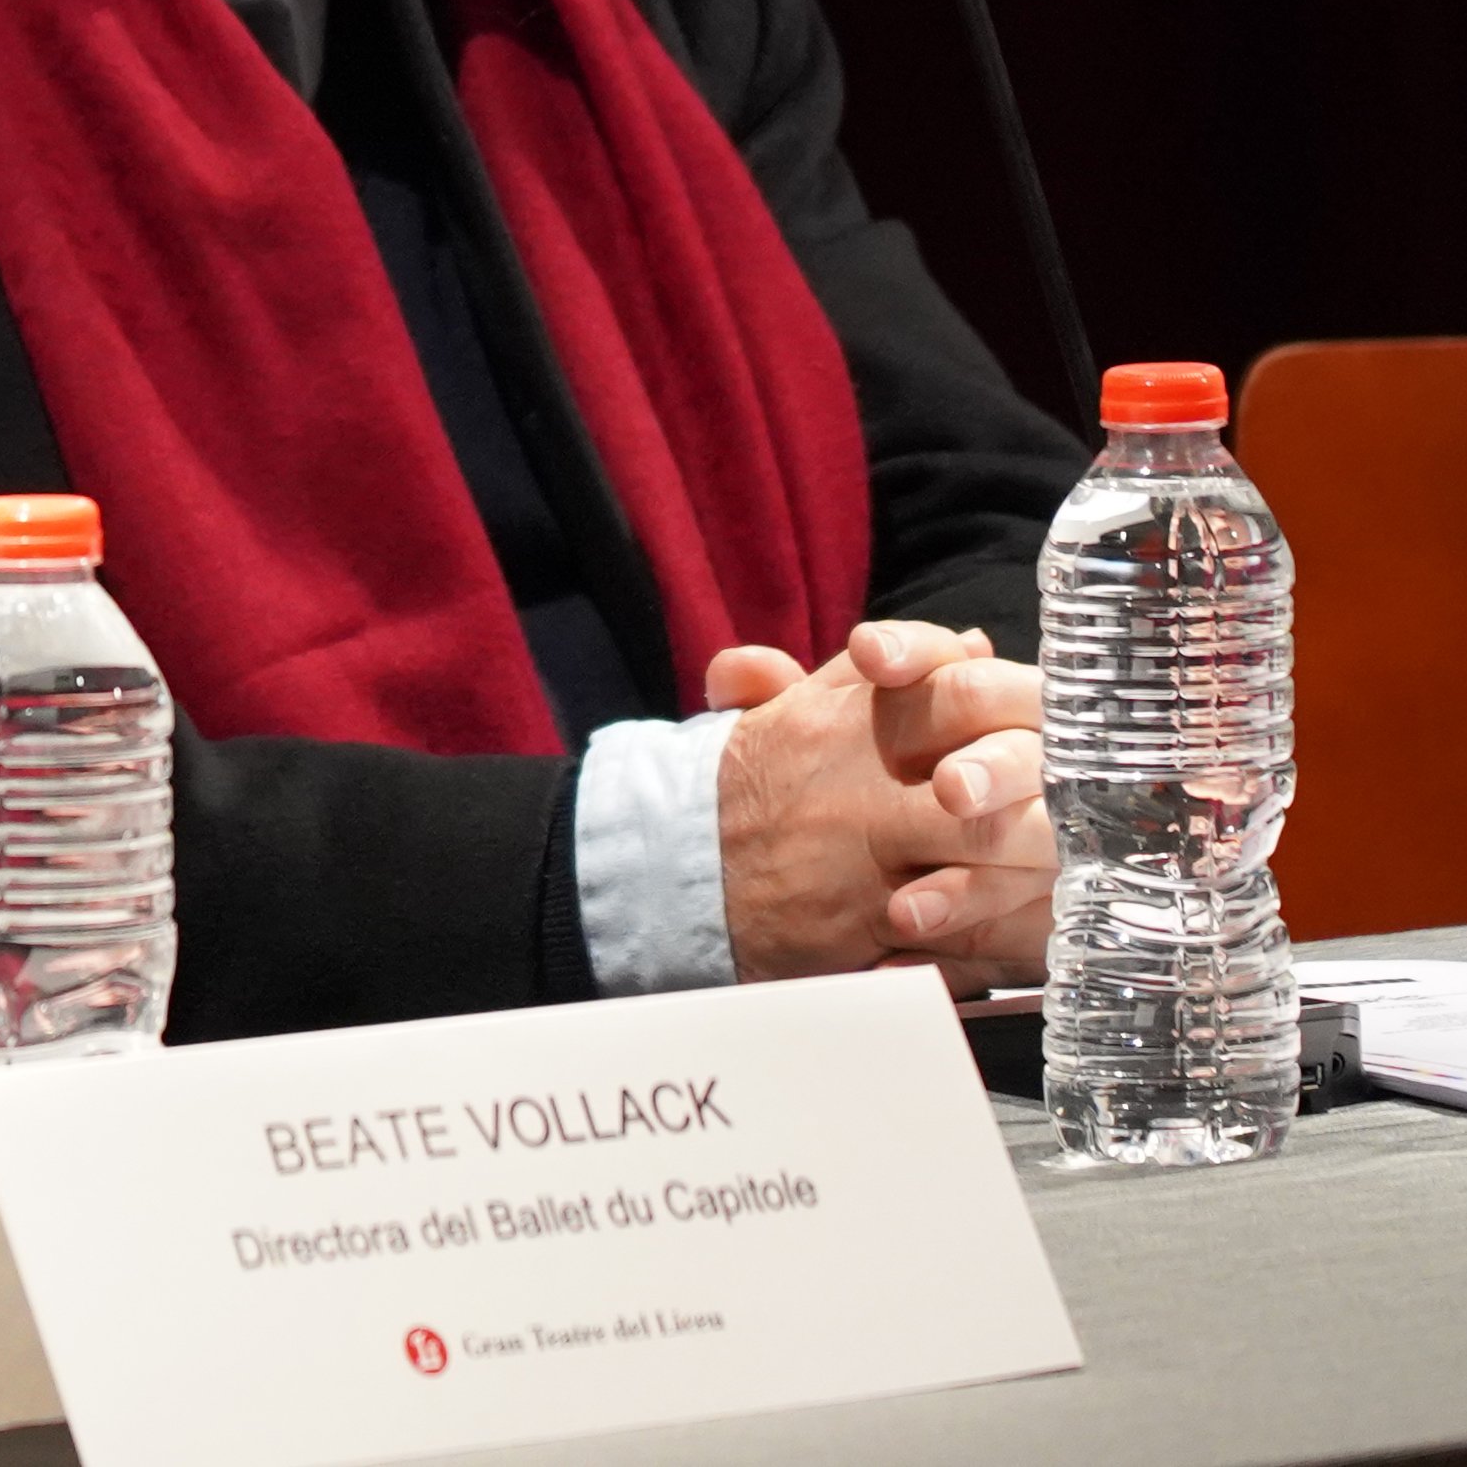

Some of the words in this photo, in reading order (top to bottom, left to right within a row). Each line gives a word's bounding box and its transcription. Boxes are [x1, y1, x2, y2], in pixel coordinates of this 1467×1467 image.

[263, 1106, 458, 1176] BEATE
[463, 1075, 733, 1153] VOLLACK
[230, 1221, 412, 1271] Directora
[416, 1210, 480, 1249] del
[485, 1195, 599, 1242] Ballet
[605, 1189, 656, 1228] du
[662, 1171, 819, 1225] Capitole
[461, 1332, 524, 1360] Gran
[613, 1315, 651, 1340] del
